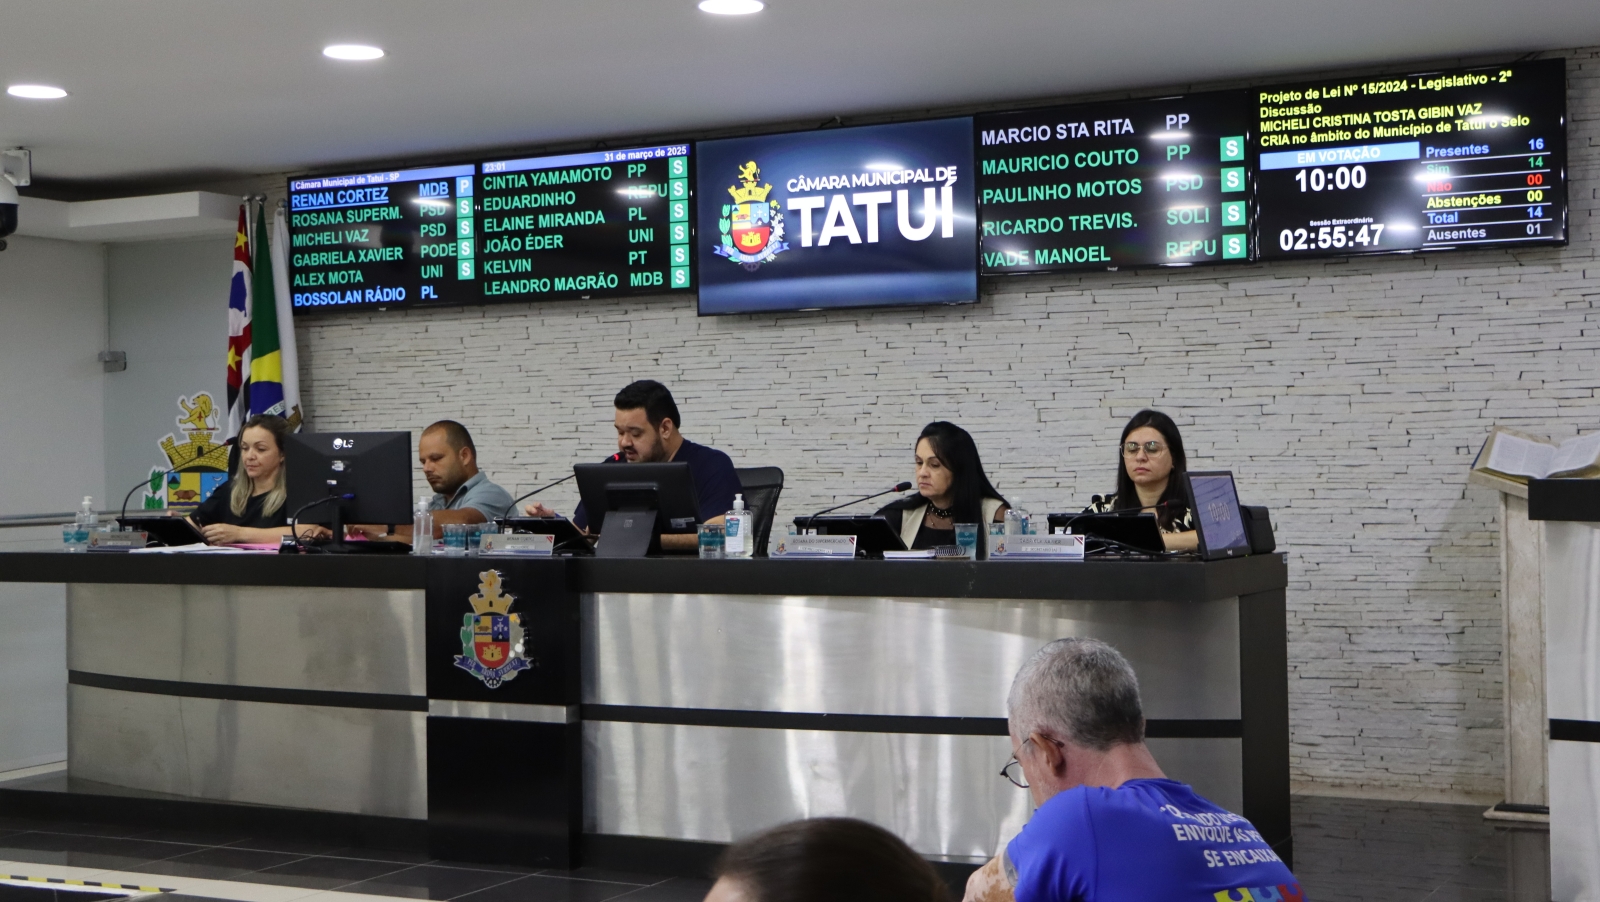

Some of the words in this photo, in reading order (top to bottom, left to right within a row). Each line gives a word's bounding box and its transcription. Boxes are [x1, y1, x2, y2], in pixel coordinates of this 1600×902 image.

[1260, 91, 1302, 104] Projeto
[1305, 88, 1320, 100] de
[1322, 86, 1340, 98] Lei
[1361, 80, 1408, 95] 15/2024
[1419, 74, 1487, 91] Legislativo
[1499, 70, 1512, 82] 2ª
[1260, 104, 1322, 118] Discussão
[1260, 118, 1310, 132] MICHELI
[1313, 113, 1371, 128] CRISTINA
[1374, 108, 1416, 123] TOSTA
[1418, 105, 1453, 119] GIBIN
[1457, 103, 1482, 116] VAZ
[982, 125, 1051, 146] MARCIO
[1056, 122, 1090, 140] STA
[1094, 118, 1134, 136] RITA
[1166, 114, 1190, 130] PP
[1260, 134, 1290, 146] CRIA
[1292, 135, 1307, 144] no
[1310, 130, 1351, 142] âmbito
[1354, 128, 1370, 139] do
[1373, 123, 1432, 138] Município
[1436, 121, 1451, 132] de
[1489, 120, 1497, 128] o
[1501, 115, 1529, 127] Selo
[604, 153, 613, 161] 31
[616, 152, 626, 160] de
[628, 151, 653, 160] março
[655, 149, 665, 157] de
[667, 146, 686, 156] 2025
[982, 153, 1070, 175] MAURICIO
[1074, 148, 1139, 168] COUTO
[1166, 145, 1190, 161] PP
[1226, 140, 1238, 157] S
[1298, 152, 1316, 164] EM
[1318, 146, 1380, 162] VOTAÇÃO
[1426, 144, 1490, 158] Presentes
[1528, 138, 1544, 150] 16
[483, 173, 528, 191] CINTIA
[531, 166, 612, 186] YAMAMOTO
[628, 164, 646, 178] PP
[673, 160, 683, 174] S
[485, 163, 506, 172] 23:01
[1427, 164, 1450, 174] Sim
[1528, 156, 1544, 168] 14
[296, 181, 321, 190] Câmara
[323, 177, 355, 187] Municipal
[390, 172, 399, 181] SP
[787, 174, 850, 192] CÂMARA
[852, 168, 934, 187] MUNICIPAL
[935, 166, 957, 181] DE
[983, 183, 1071, 205] PAULINHO
[1076, 178, 1142, 198] MOTOS
[1166, 174, 1203, 192] PSD
[1226, 171, 1239, 188] S
[1295, 165, 1366, 192] 10:00
[1527, 174, 1543, 185] 00
[292, 192, 334, 208] RENAN
[337, 186, 388, 203] CORTEZ
[419, 182, 449, 196] MDB
[460, 180, 469, 192] P
[484, 191, 576, 211] EDUARDINHO
[628, 183, 668, 199] REPU
[673, 182, 684, 196] S
[1427, 194, 1502, 208] Abstenções
[1527, 190, 1543, 202] 00
[292, 211, 344, 227] ROSANA
[347, 206, 403, 223] SUPERM.
[420, 203, 446, 217] PSD
[461, 200, 469, 214] S
[484, 216, 534, 232] ELAINE
[538, 210, 605, 228] MIRANDA
[629, 207, 647, 221] PL
[674, 203, 684, 218] S
[787, 179, 957, 247] TATUÍ
[983, 217, 1064, 236] RICARDO
[1069, 212, 1138, 232] TREVIS.
[1166, 208, 1210, 226] SOLI
[1227, 205, 1240, 222] S
[1332, 217, 1373, 226] Extraordinária
[1427, 211, 1458, 224] Total
[1527, 206, 1542, 218] 14
[293, 232, 342, 247] MICHELI
[346, 229, 369, 243] VAZ
[420, 223, 446, 237] PSD
[461, 221, 469, 234] S
[484, 236, 521, 254] JOÃO
[525, 234, 563, 250] ÉDER
[629, 228, 653, 243] UNI
[674, 226, 684, 240] S
[1279, 224, 1384, 251] 02:55:47
[1427, 228, 1486, 241] Ausentes
[1527, 223, 1540, 234] 01
[293, 250, 356, 267] GABRIELA
[358, 247, 403, 263] XAVIER
[421, 243, 457, 258] PODE
[462, 242, 470, 255] S
[484, 258, 532, 275] KELVIN
[629, 250, 647, 265] PT
[675, 248, 685, 262] S
[984, 251, 1030, 267] VADE
[1035, 246, 1111, 265] MANOEL
[1166, 240, 1217, 258] REPU
[1228, 238, 1240, 254] S
[294, 272, 325, 286] ALEX
[329, 270, 364, 284] MOTA
[421, 265, 443, 279] UNI
[462, 262, 470, 276] S
[484, 278, 550, 295] LEANDRO
[554, 272, 618, 291] MAGRÃO
[630, 272, 663, 286] MDB
[676, 270, 685, 284] S
[294, 290, 362, 307] BOSSOLAN
[366, 286, 406, 302] RÁDIO
[421, 286, 438, 299] PL
[1208, 502, 1230, 522] 10:00
[1172, 824, 1234, 843] ENVOLVE
[1234, 827, 1251, 842] AS
[1203, 850, 1224, 867] SE
